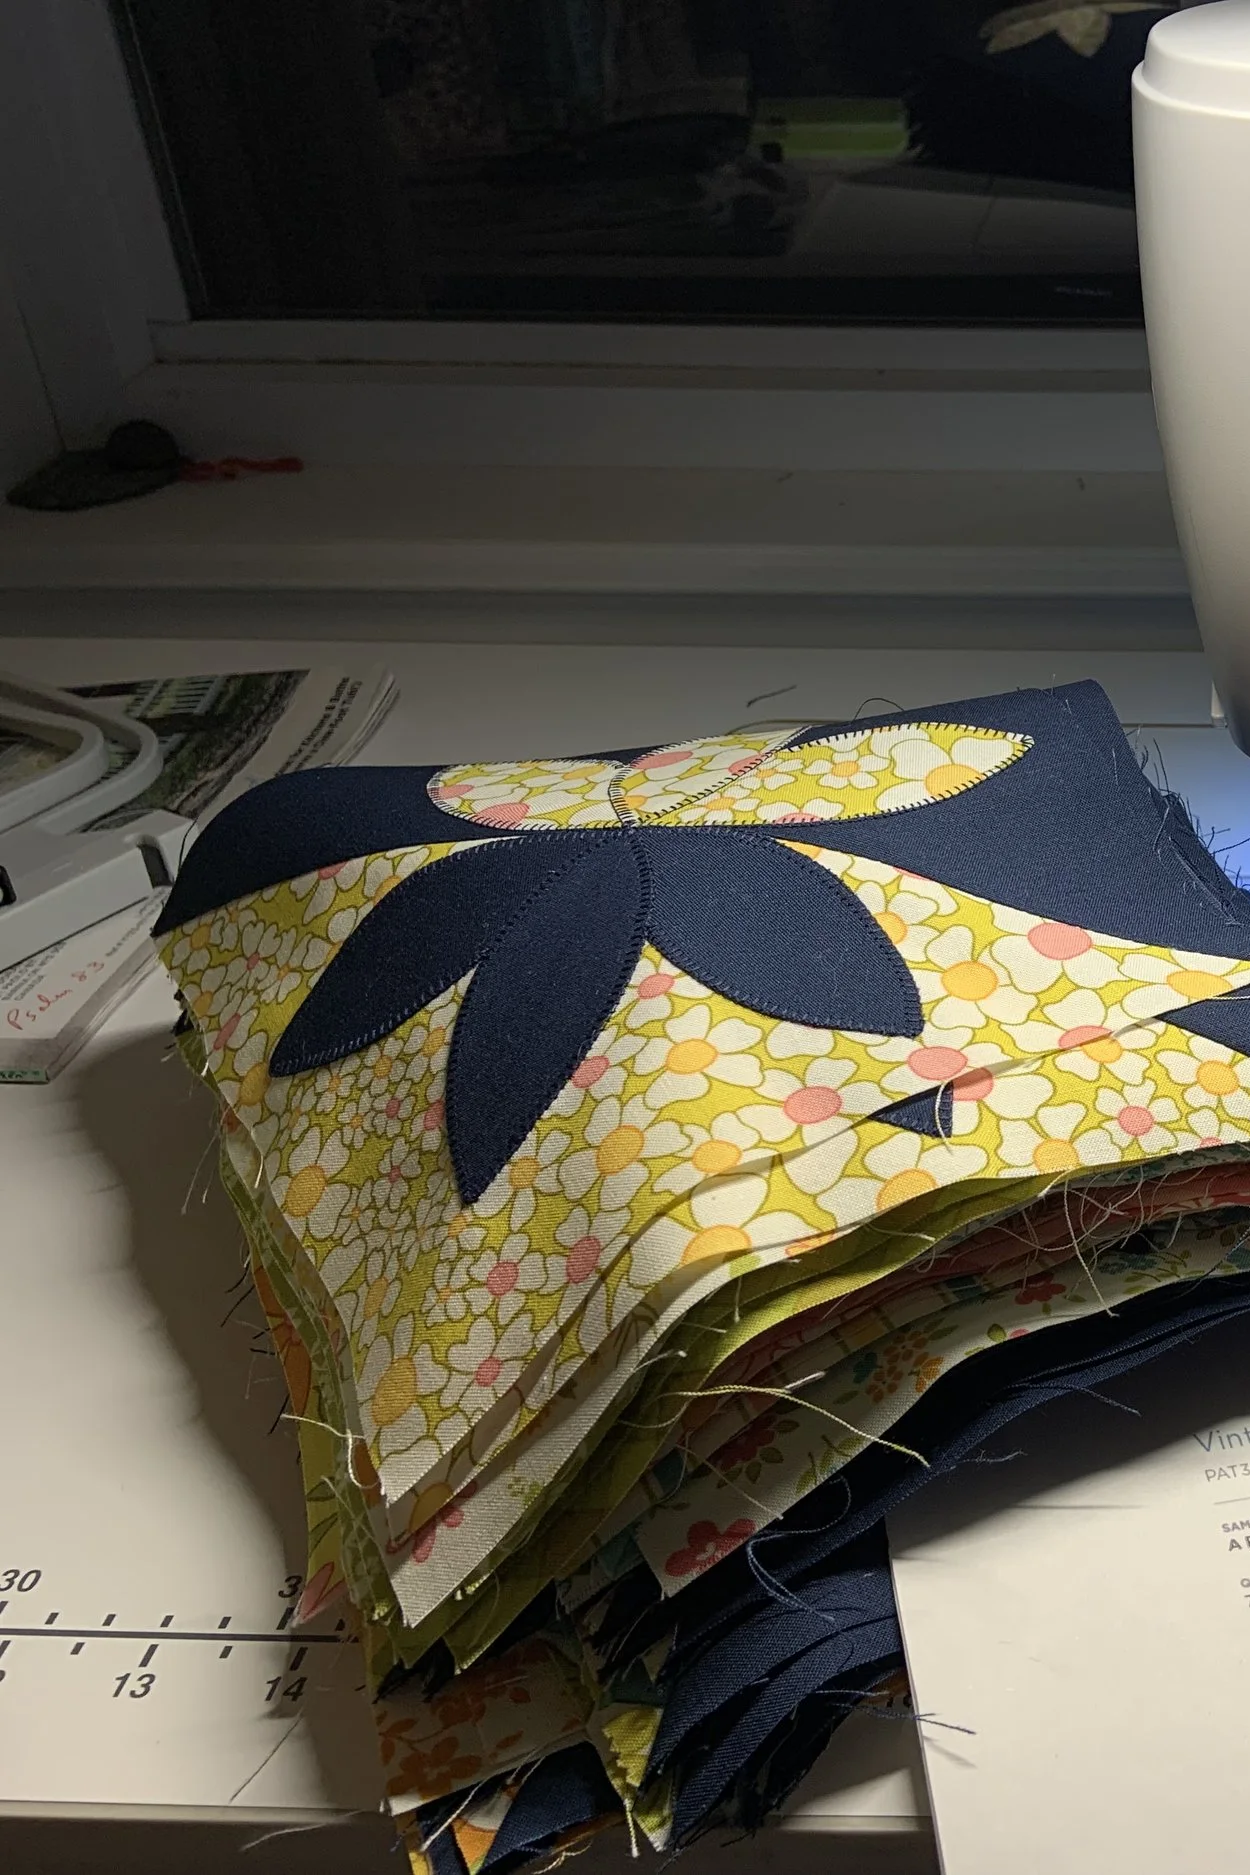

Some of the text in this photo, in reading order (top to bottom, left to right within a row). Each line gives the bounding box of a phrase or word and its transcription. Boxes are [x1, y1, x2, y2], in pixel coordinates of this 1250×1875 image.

[1228, 1538, 1242, 1551] A
[0, 1569, 42, 1592] 30
[111, 1673, 156, 1699] 13
[265, 1676, 308, 1702] 14
